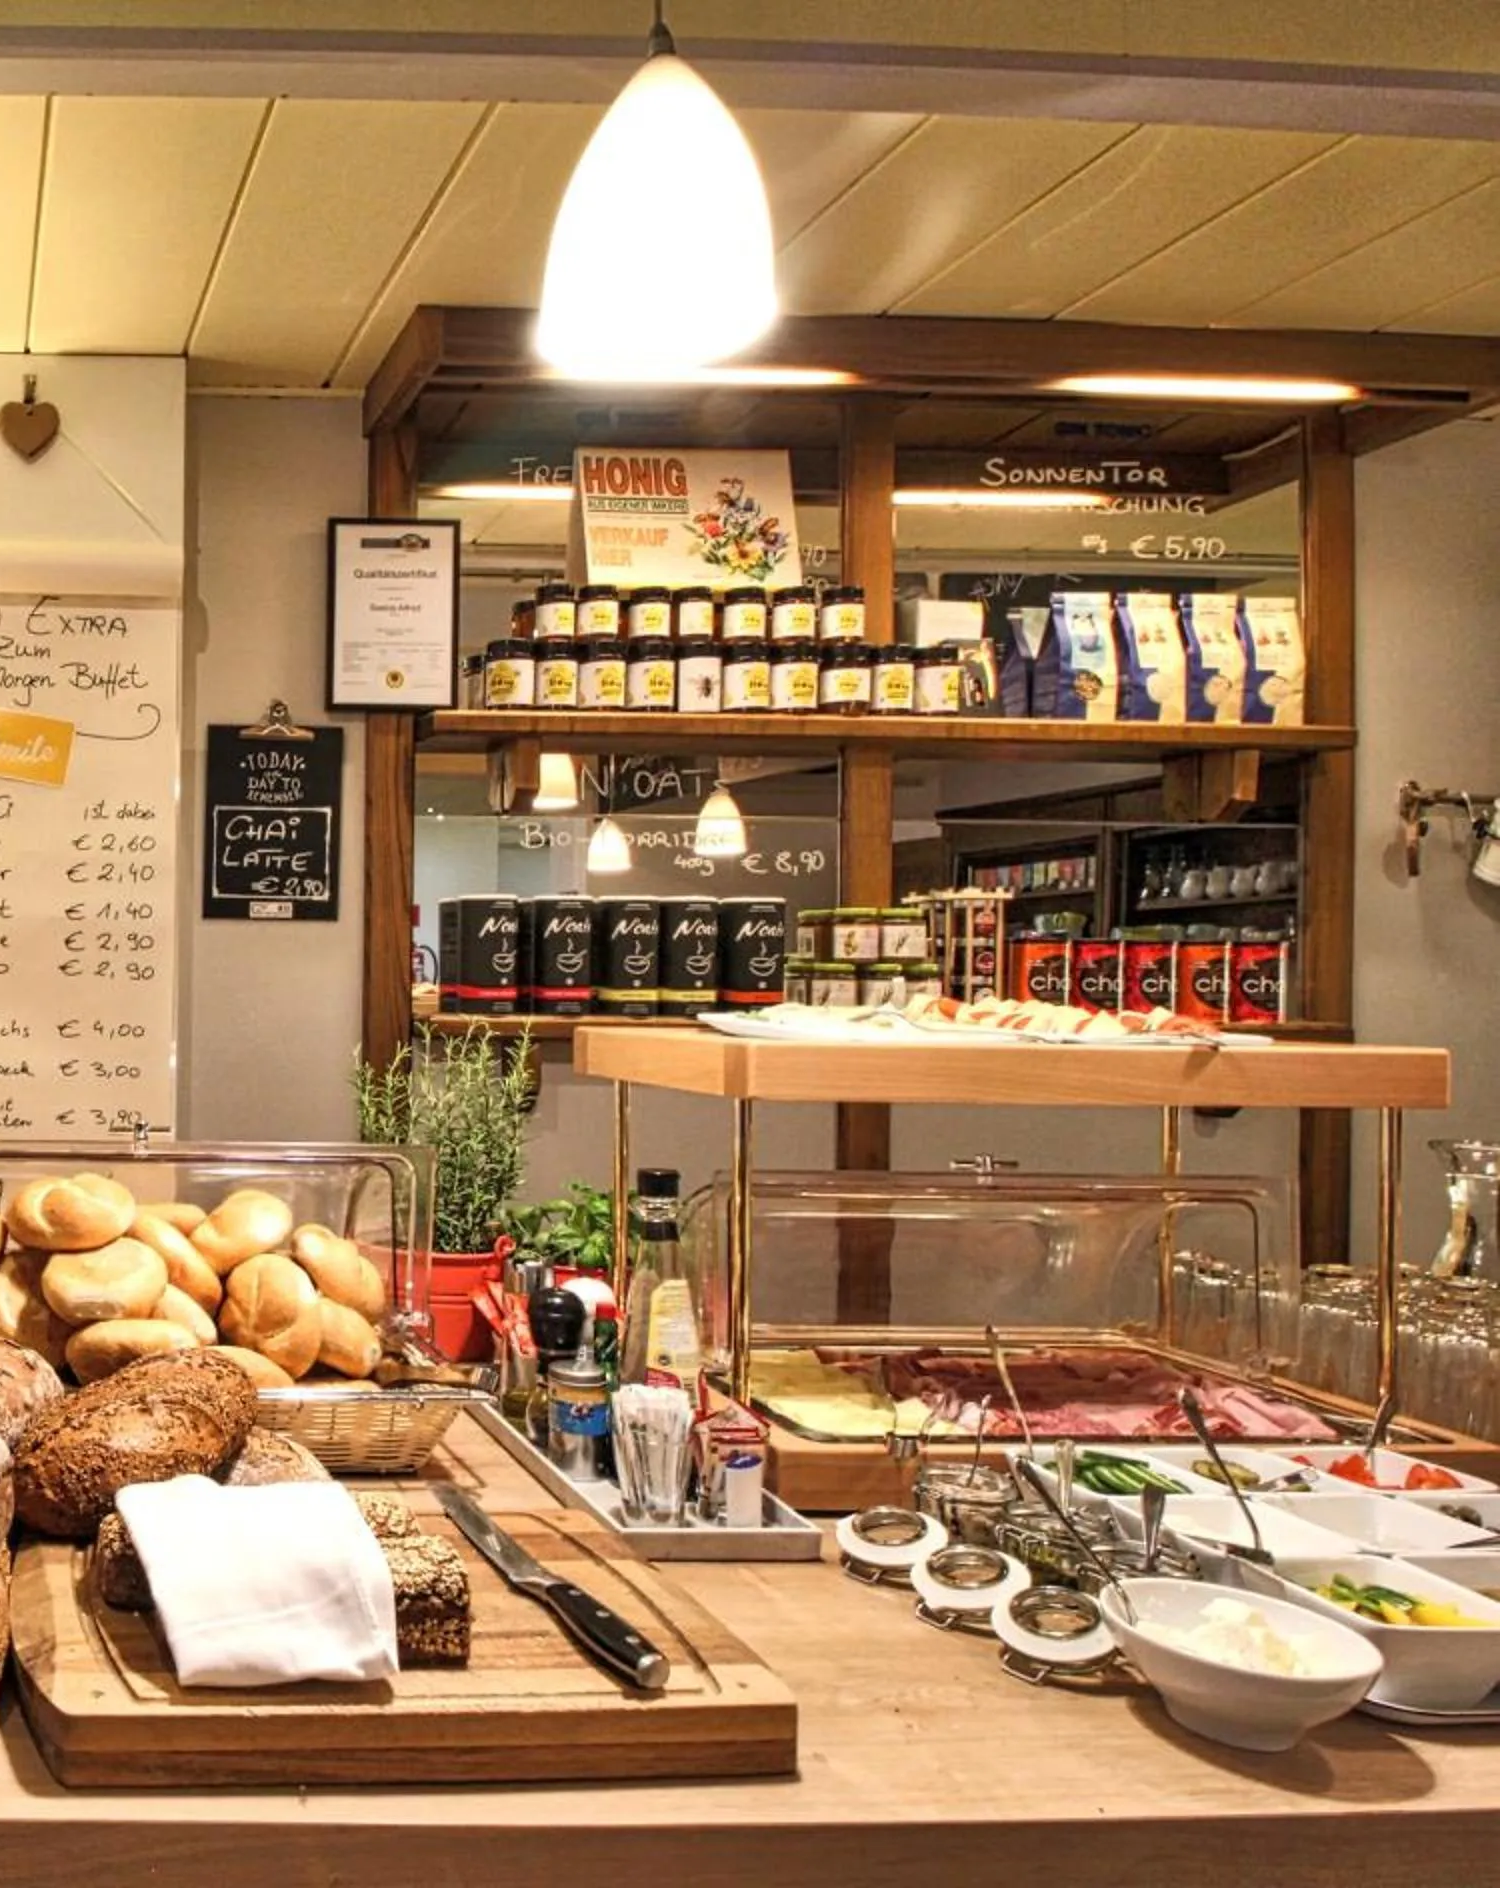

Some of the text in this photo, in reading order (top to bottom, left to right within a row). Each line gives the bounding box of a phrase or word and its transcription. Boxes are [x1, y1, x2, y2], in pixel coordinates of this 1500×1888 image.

[583, 456, 688, 496] HONIG
[980, 457, 1168, 487] SONNENTOR
[589, 527, 669, 547] VERKAUF
[1130, 535, 1158, 559] €
[1164, 536, 1226, 561] 5,90
[25, 595, 128, 637] EXTRA
[60, 661, 149, 700] Buffet
[72, 833, 92, 851] €
[100, 833, 157, 854] 2,60
[66, 862, 89, 884] €
[97, 862, 155, 884] 2,40
[740, 853, 769, 875] €
[774, 850, 826, 877] 8,90
[251, 876, 325, 896] € 2,90
[64, 903, 85, 921] €
[96, 903, 154, 922] 1,40
[64, 931, 86, 951] €
[99, 933, 155, 952] 2,90
[58, 959, 83, 977] €
[94, 960, 155, 981] 2,90
[57, 1018, 81, 1039] €
[92, 1018, 146, 1040] 4,00
[59, 1058, 80, 1077] €
[90, 1060, 142, 1080] 3,00
[55, 1108, 76, 1126] €
